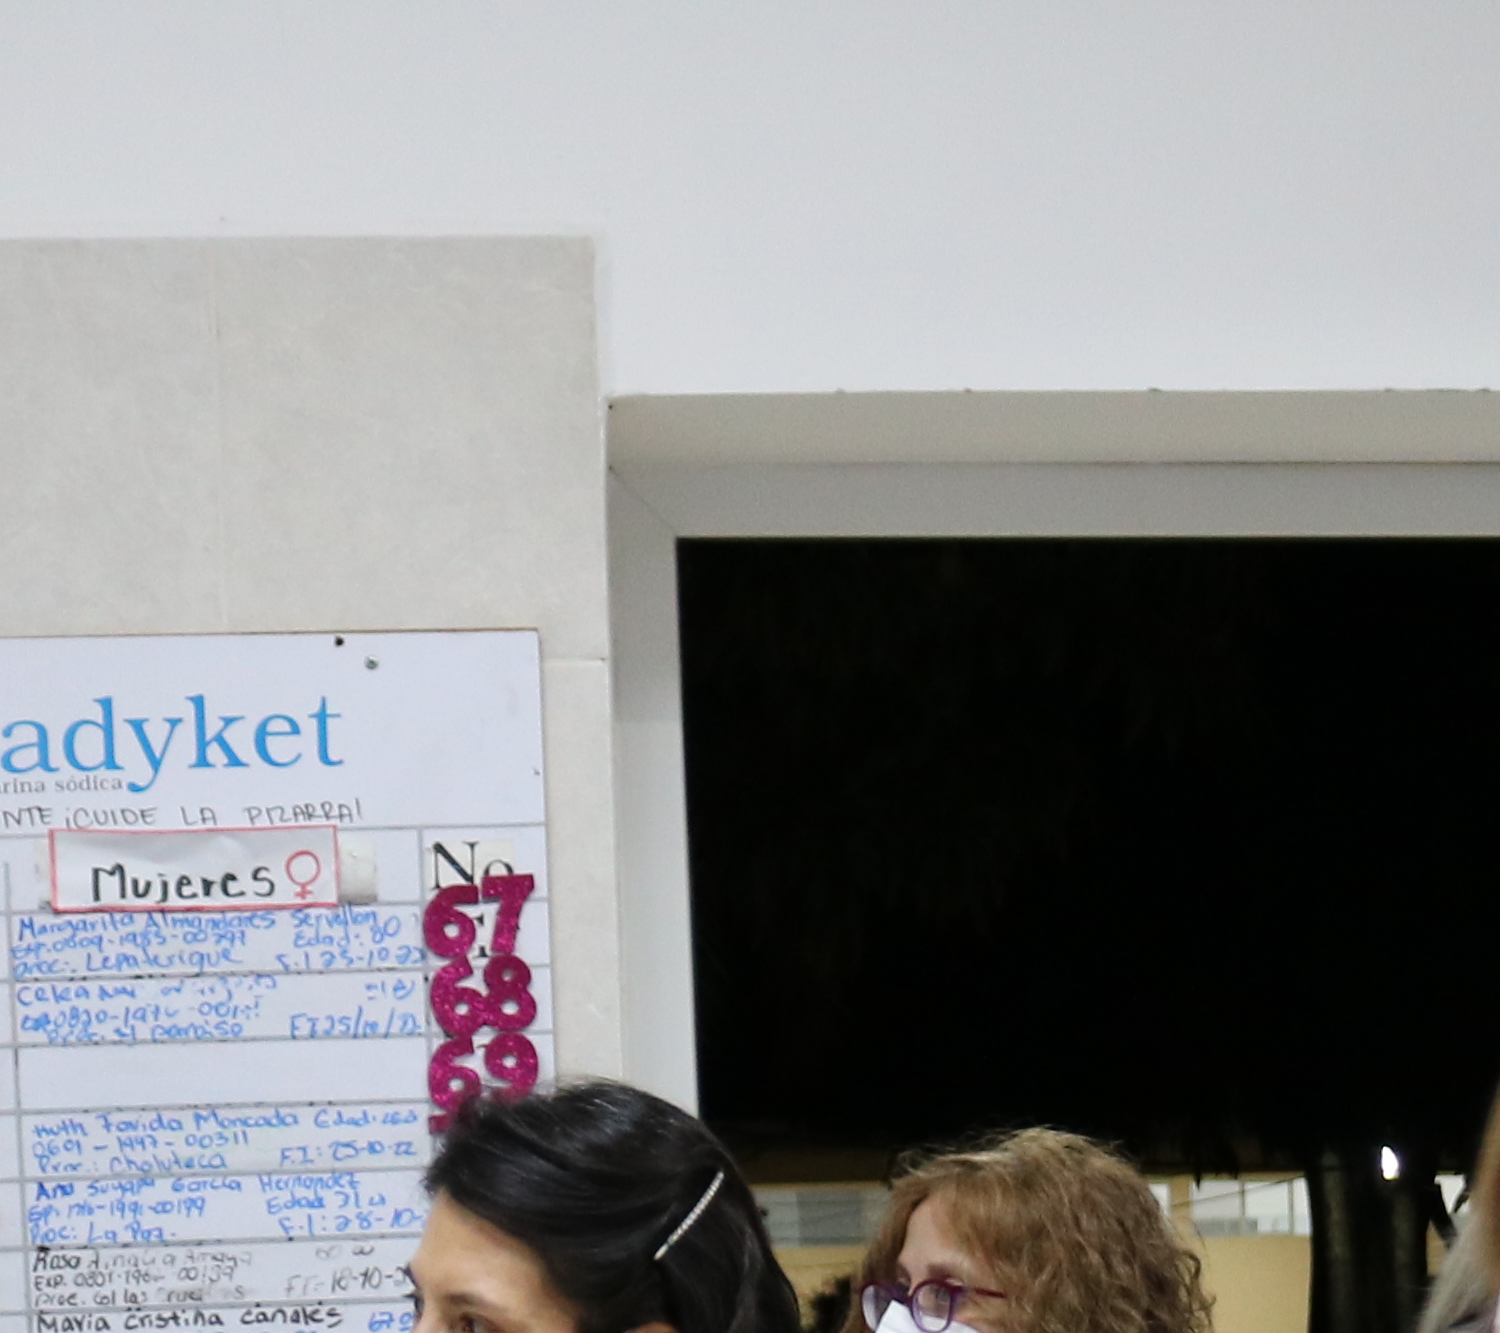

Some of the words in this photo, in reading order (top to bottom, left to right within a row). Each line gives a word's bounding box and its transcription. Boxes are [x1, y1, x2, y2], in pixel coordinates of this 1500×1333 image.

[54, 773, 124, 794] sódica
[181, 804, 218, 826] LA
[91, 862, 276, 904] Mujeres
[423, 872, 536, 958] 67
[429, 952, 538, 1038] 68
